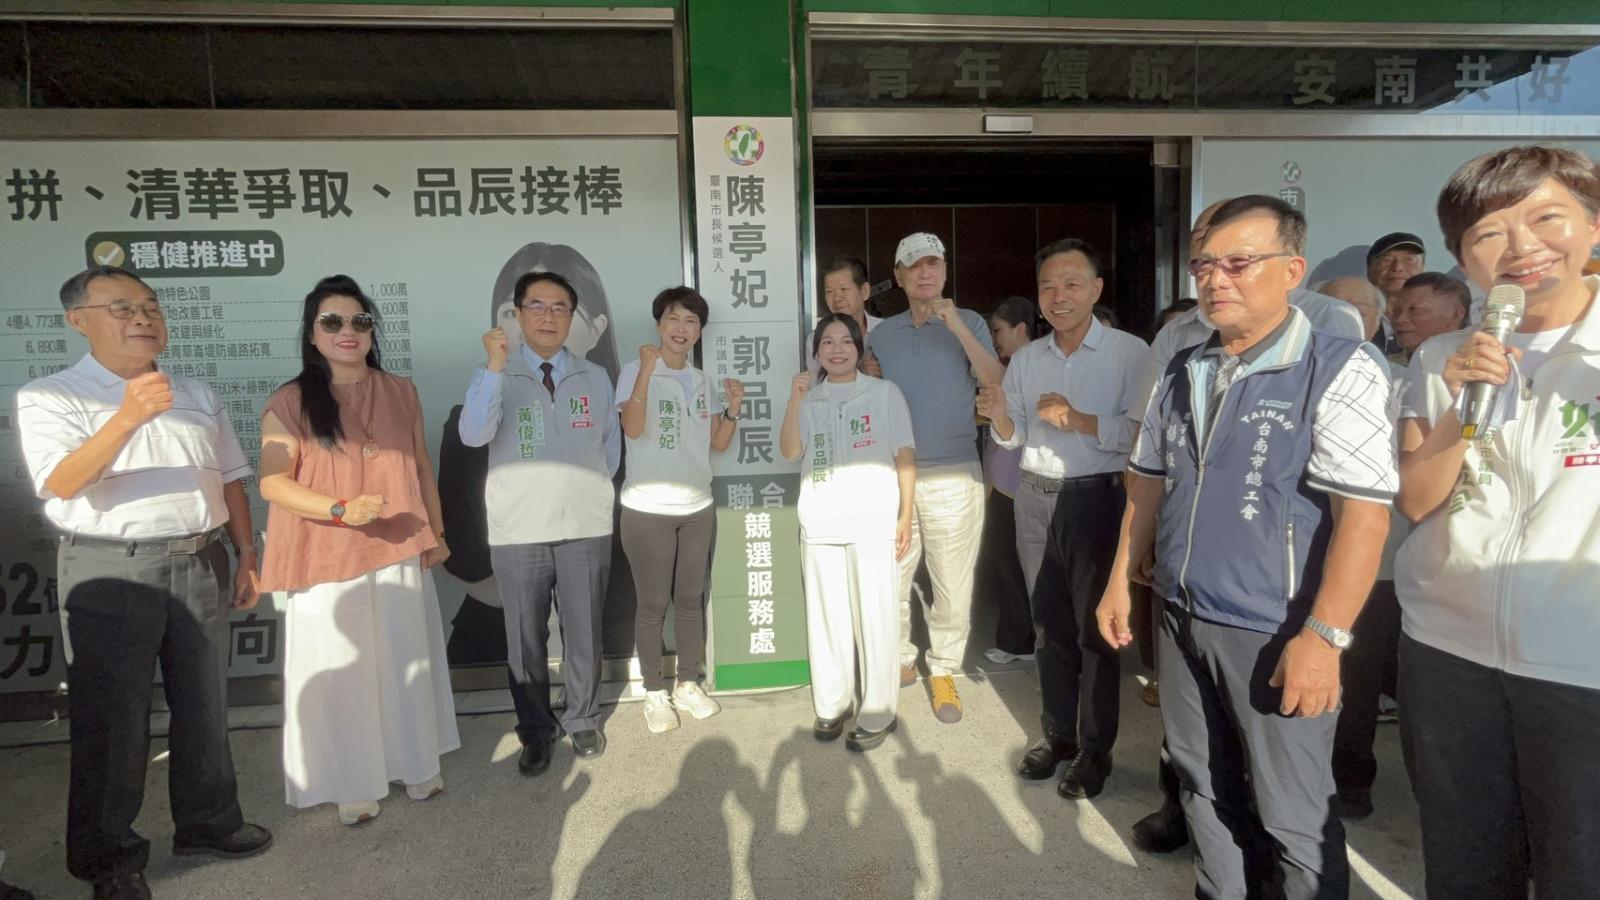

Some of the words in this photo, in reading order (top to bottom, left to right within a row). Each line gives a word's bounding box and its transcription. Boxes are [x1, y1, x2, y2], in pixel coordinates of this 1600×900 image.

[866, 46, 1179, 100] 青年續航
[1293, 54, 1572, 106] 安南共好
[709, 174, 724, 273] 臺南市長候選人
[726, 174, 769, 309] 陳亭妃
[130, 240, 275, 269] 穩健推進中
[6, 314, 65, 330] 4億4,773萬
[25, 339, 68, 354] 6,890萬
[658, 399, 675, 450] 陳亭妃
[732, 335, 774, 465] 郭品辰
[1240, 409, 1295, 431] TAINAN
[516, 406, 537, 460] 黃偉哲
[812, 432, 827, 483] 郭品辰
[727, 482, 786, 510] 聯合
[1240, 421, 1272, 521] 台南市總工會
[744, 512, 776, 655] 競選服務處
